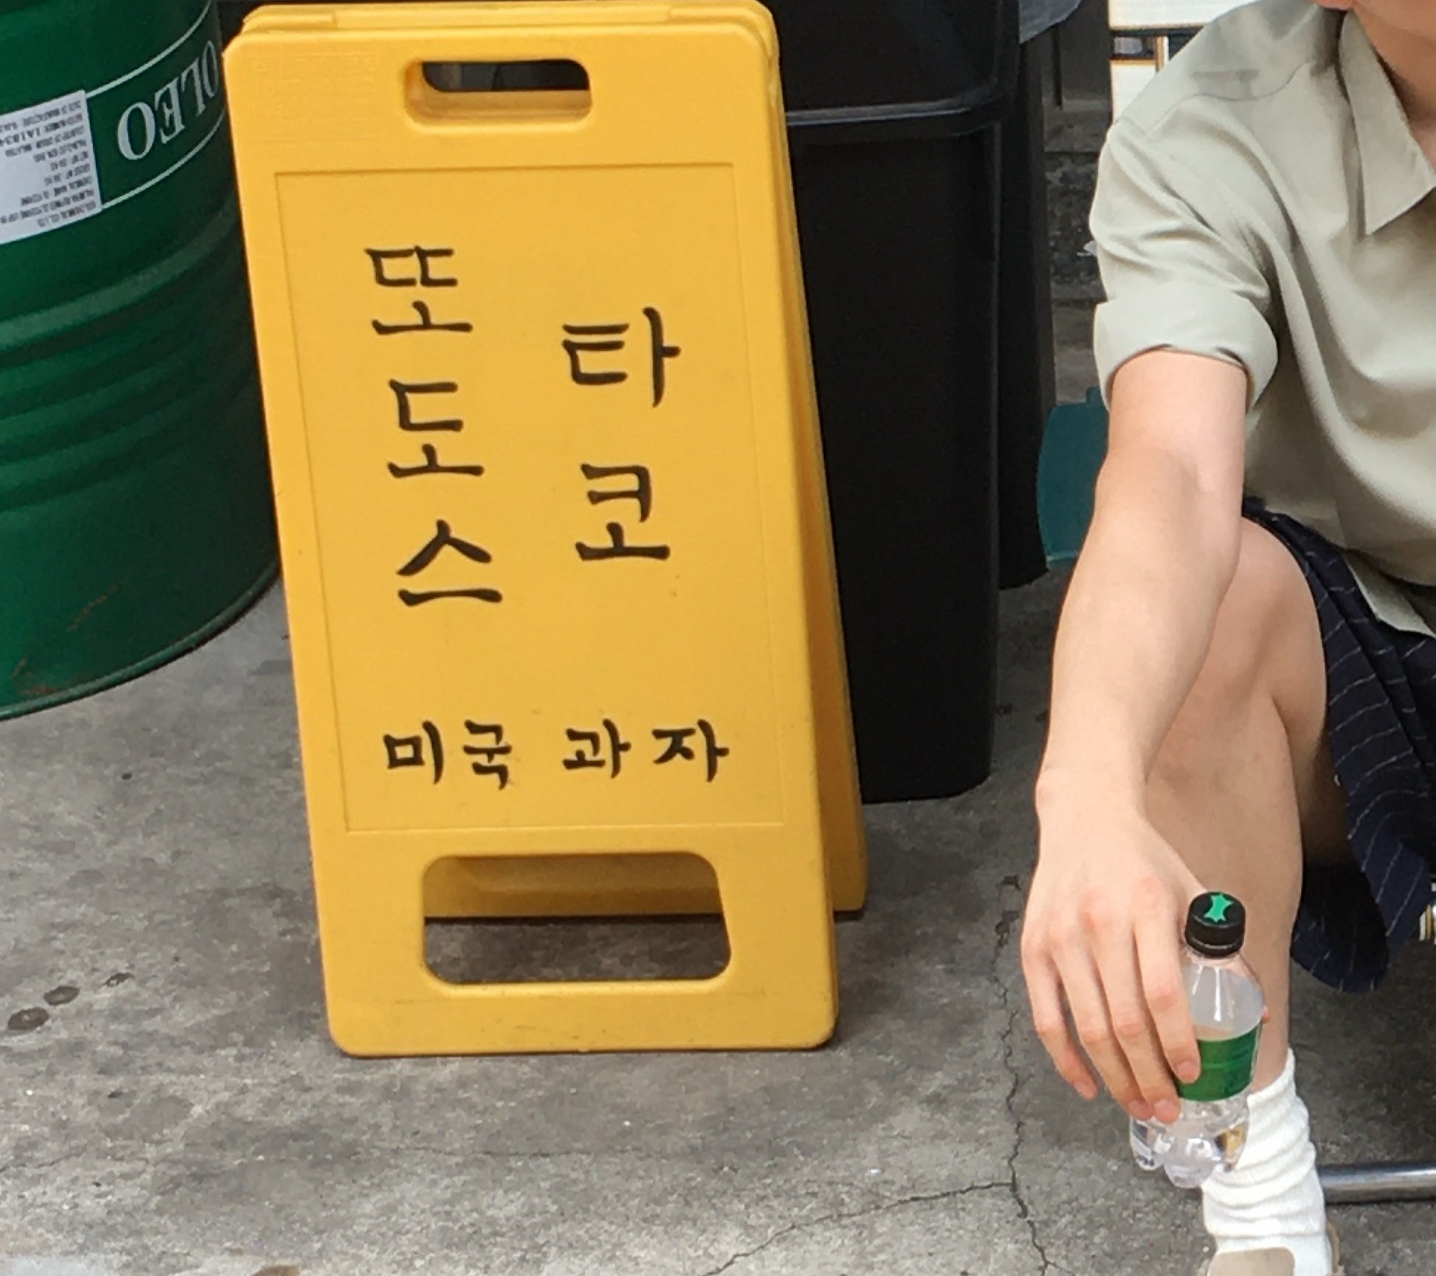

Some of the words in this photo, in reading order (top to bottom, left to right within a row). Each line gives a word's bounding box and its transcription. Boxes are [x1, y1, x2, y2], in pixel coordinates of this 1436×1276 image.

[116, 39, 219, 161] OLEO
[364, 245, 503, 607] 또도스
[561, 305, 682, 563] 타코
[382, 718, 513, 791] 미국
[562, 717, 730, 784] 과자
